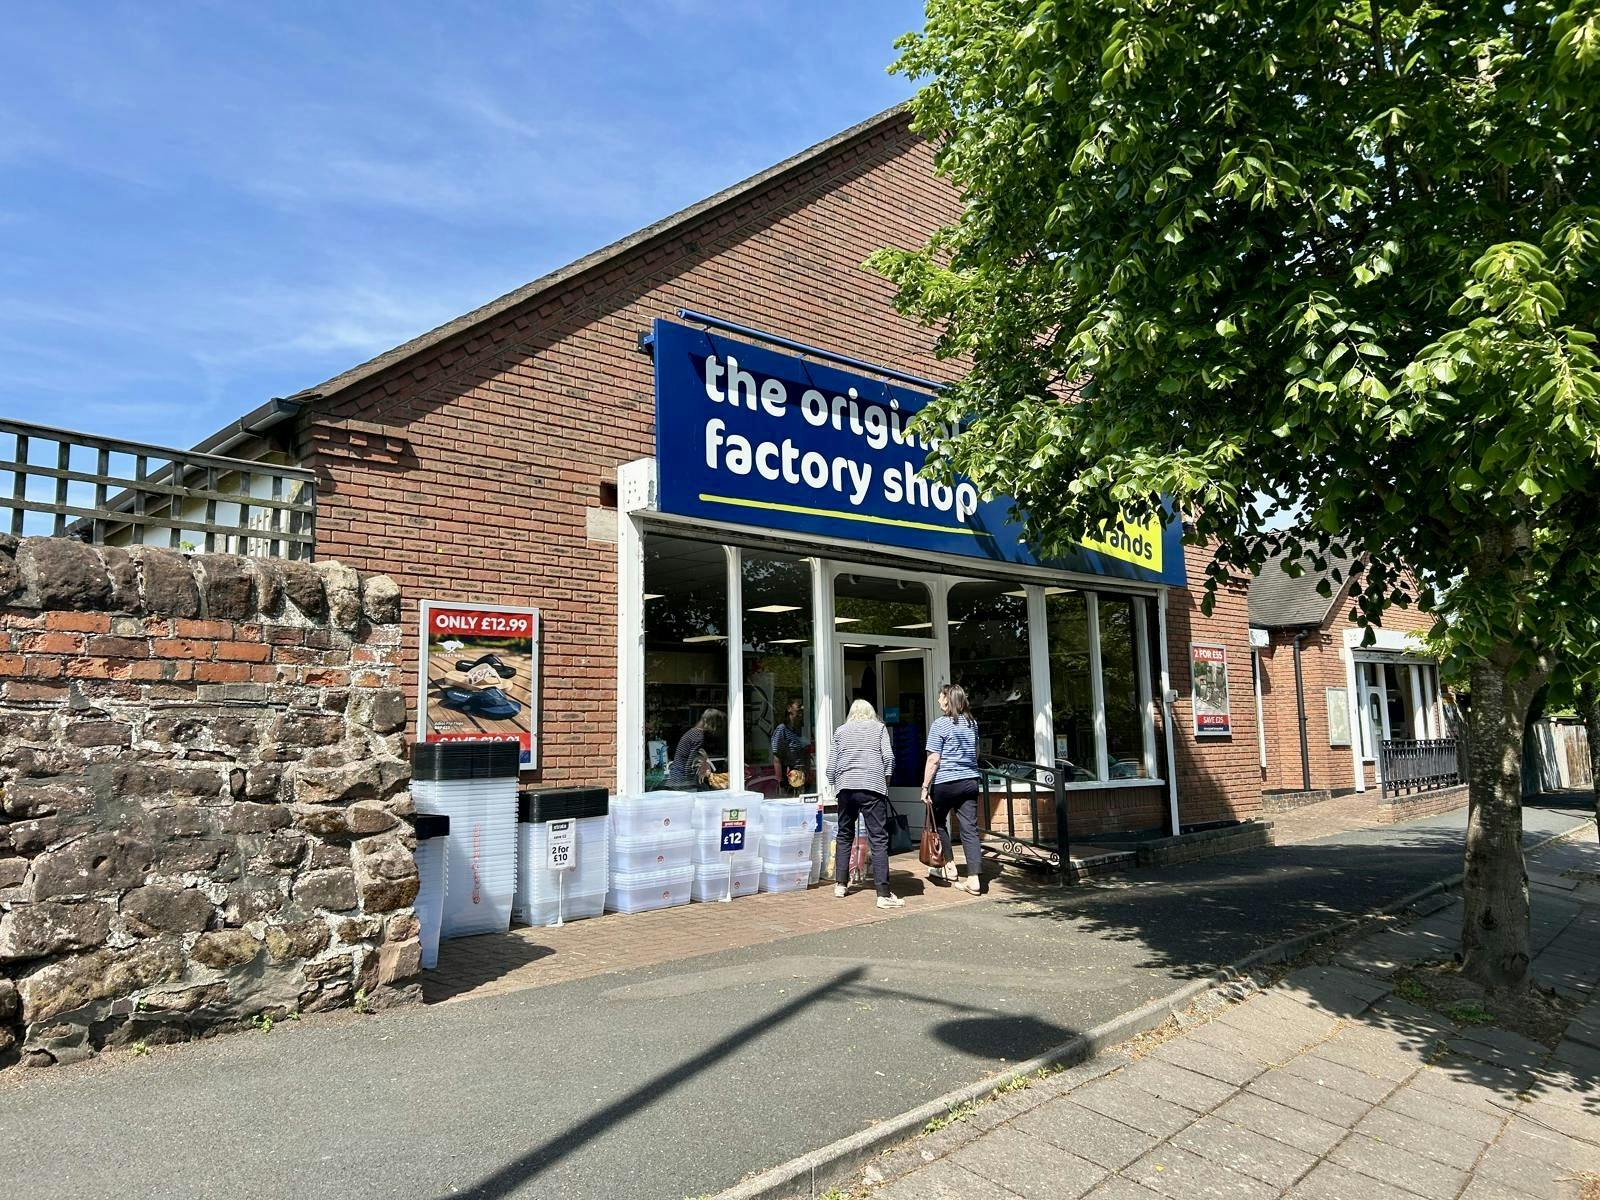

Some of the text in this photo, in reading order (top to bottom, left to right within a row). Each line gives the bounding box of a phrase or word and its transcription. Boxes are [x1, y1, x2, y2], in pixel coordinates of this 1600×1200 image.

[705, 355, 787, 417] the
[705, 418, 977, 523] factory shop
[436, 614, 527, 632] ONLY £12.99
[1194, 649, 1198, 658] 2
[1199, 650, 1211, 659] FOR
[724, 832, 741, 844] £12
[558, 845, 569, 853] for
[553, 853, 567, 862] £10
